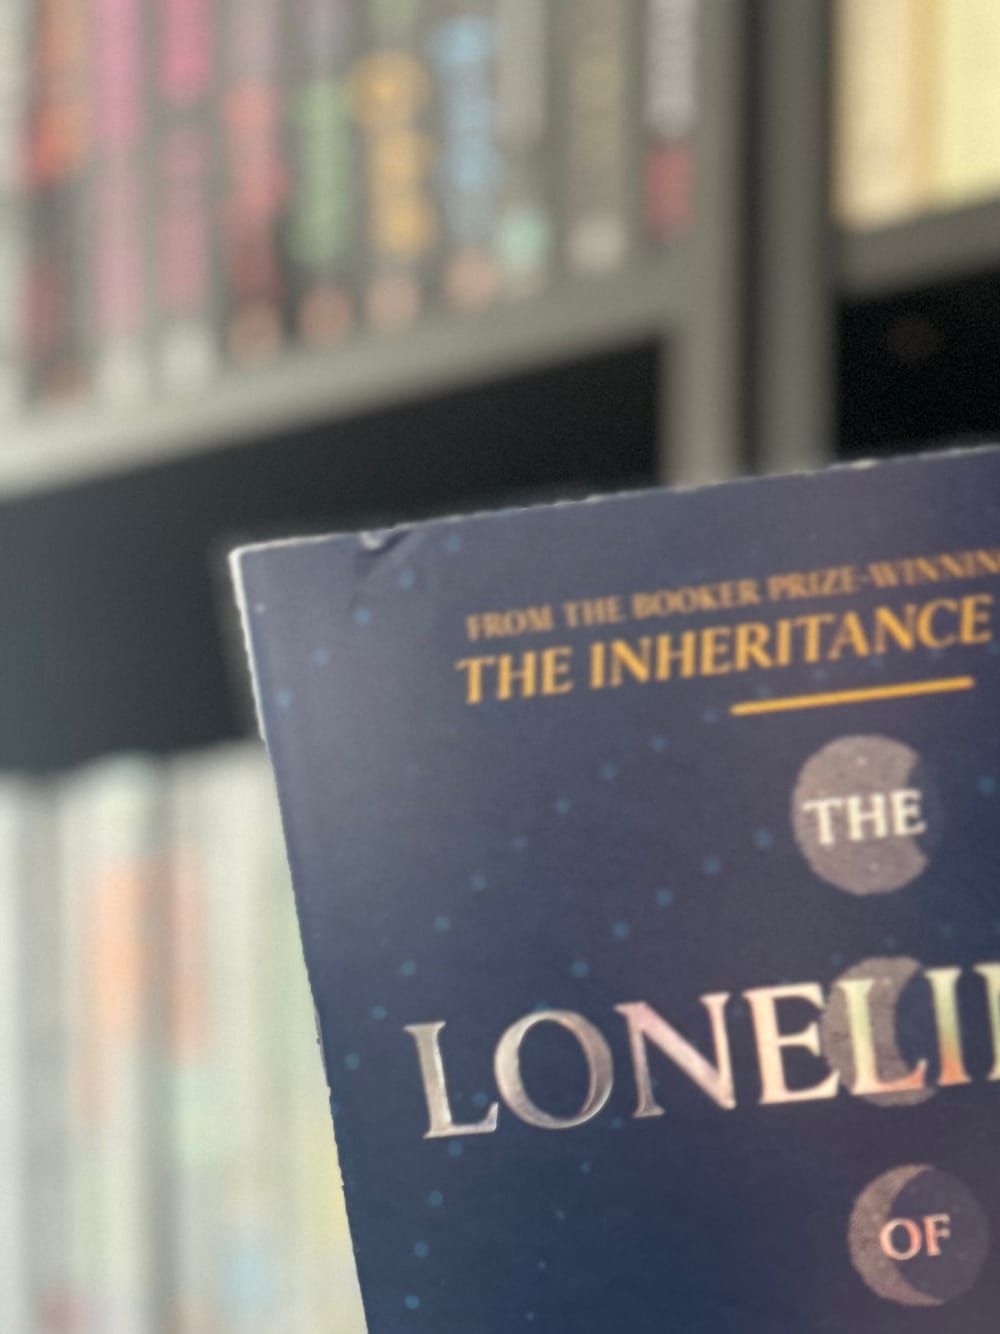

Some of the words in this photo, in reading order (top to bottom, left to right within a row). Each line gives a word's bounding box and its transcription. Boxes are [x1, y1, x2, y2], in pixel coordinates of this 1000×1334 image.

[466, 604, 556, 642] FROM
[564, 596, 625, 629] THE
[631, 579, 763, 620] BOOKER
[456, 646, 574, 704] THE
[589, 593, 993, 690] INHERITANCE
[803, 788, 926, 846] THE
[879, 1213, 951, 1261] OF
